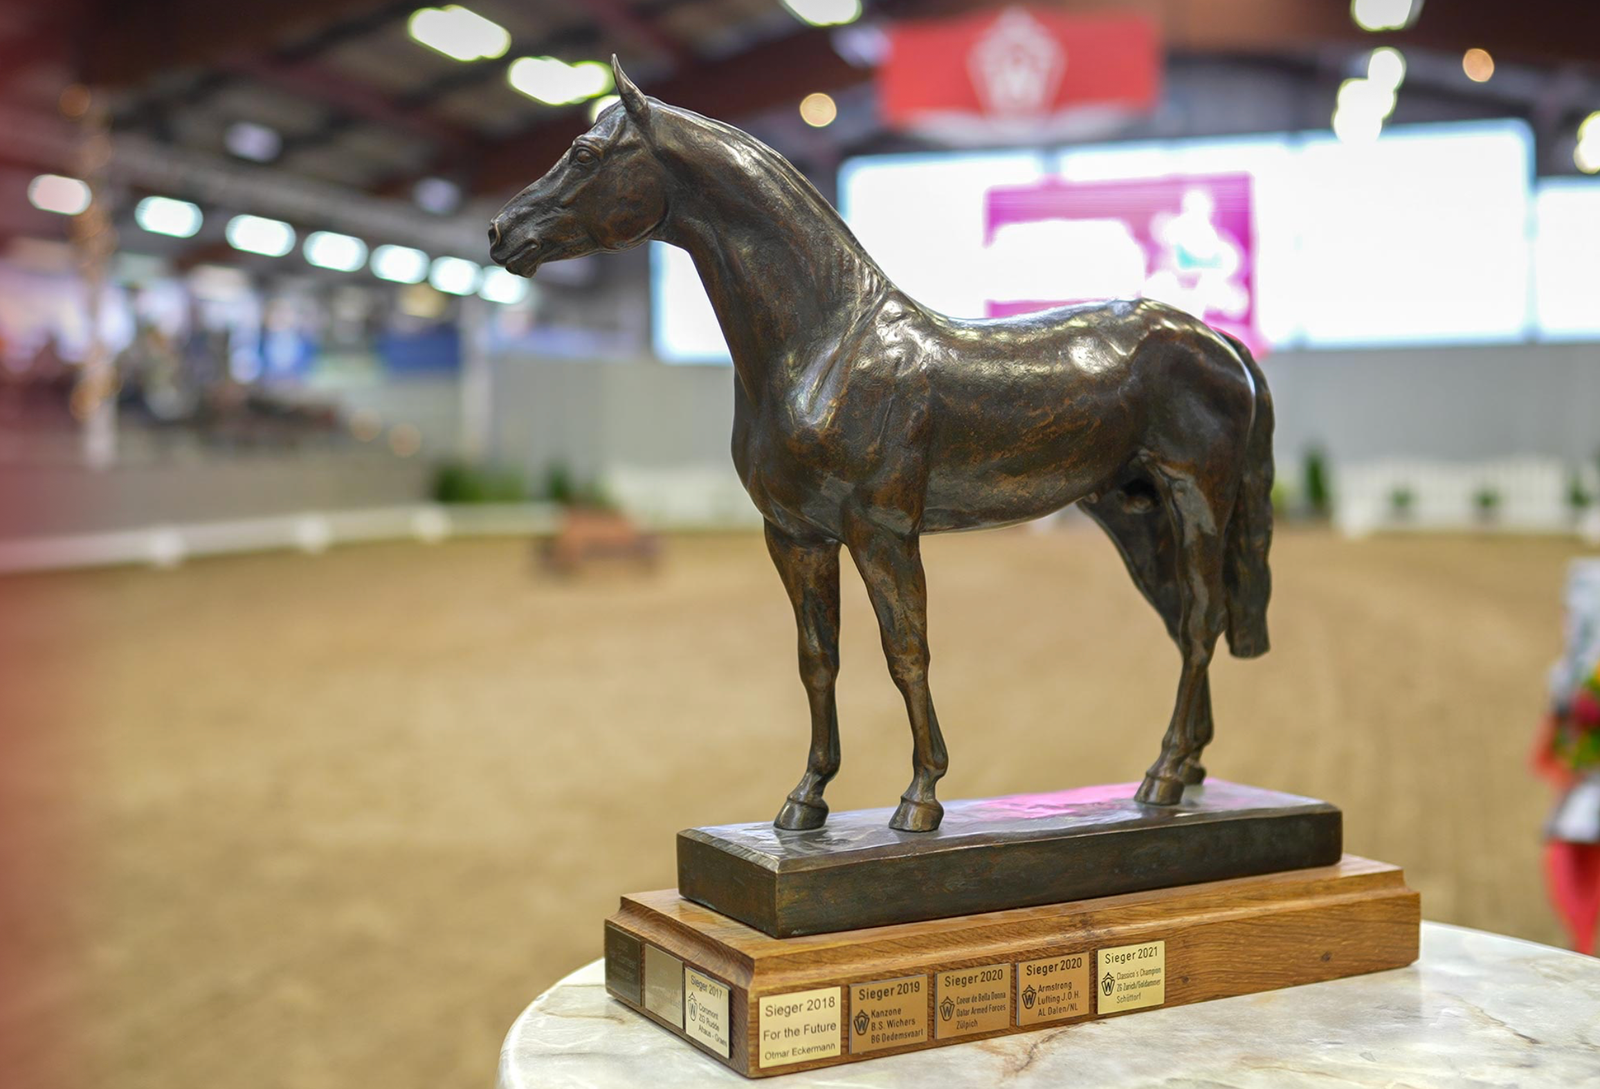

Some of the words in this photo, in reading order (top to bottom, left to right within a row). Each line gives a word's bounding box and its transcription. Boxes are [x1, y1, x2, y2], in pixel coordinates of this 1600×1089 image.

[1105, 952, 1136, 964] Sieger
[1138, 946, 1158, 959] 2021
[1026, 964, 1058, 976] Sieger
[1060, 957, 1082, 971] 2020
[944, 975, 978, 987] Sieger
[980, 968, 1003, 982] 2020
[690, 974, 708, 992] Sieger
[709, 984, 722, 999] 2017
[859, 987, 894, 1001] Sieger
[897, 981, 920, 995] 2019
[1038, 982, 1072, 993] Armstrong
[972, 994, 978, 1002] de
[991, 992, 1006, 1000] Donna
[765, 1003, 803, 1018] Sieger
[806, 996, 836, 1011] 2018
[871, 1008, 902, 1018] Kanzone
[956, 1008, 970, 1017] Qatar
[971, 1006, 988, 1015] Armed
[988, 1004, 1006, 1012] Forces
[1038, 1008, 1046, 1017] AL
[1048, 1002, 1078, 1016] Dalen/NL
[887, 1018, 916, 1028] Wichers
[956, 1018, 978, 1030] Zülpich
[764, 1030, 781, 1041] For
[784, 1027, 800, 1038] the
[804, 1022, 836, 1035] Future
[871, 1034, 880, 1044] BG
[882, 1028, 924, 1042] Dedemsvaart
[764, 1050, 790, 1060] Otmar
[792, 1043, 836, 1056] Eckermann
